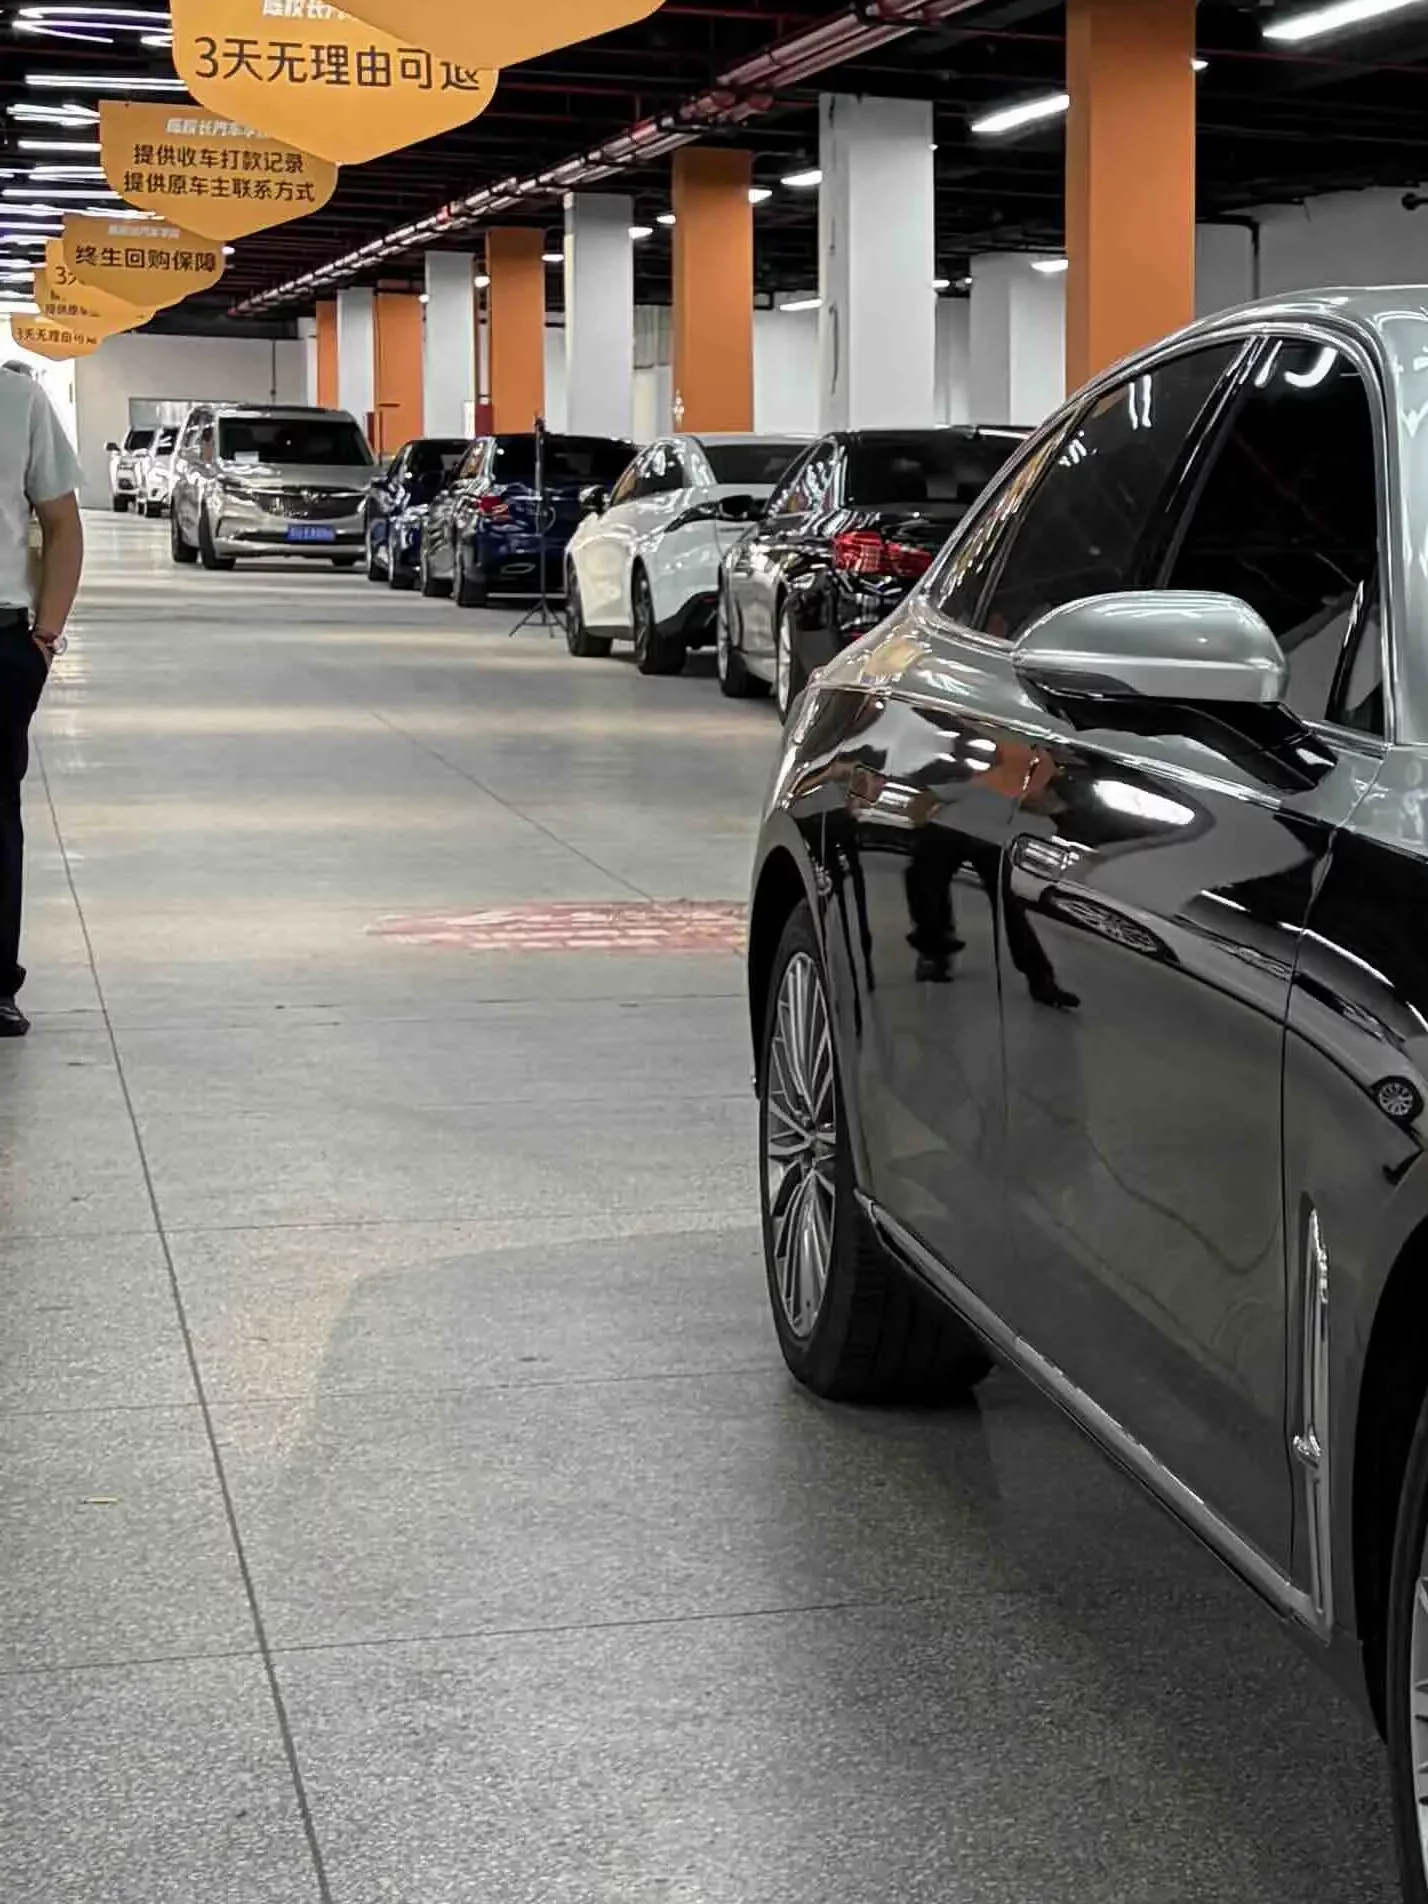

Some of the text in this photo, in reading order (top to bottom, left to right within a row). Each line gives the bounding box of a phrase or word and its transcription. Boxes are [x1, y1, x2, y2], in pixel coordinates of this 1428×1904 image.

[134, 144, 304, 174] 提供收车打款记录
[124, 171, 316, 202] 提供原车主联系方式
[75, 245, 216, 273] 终生回购保障
